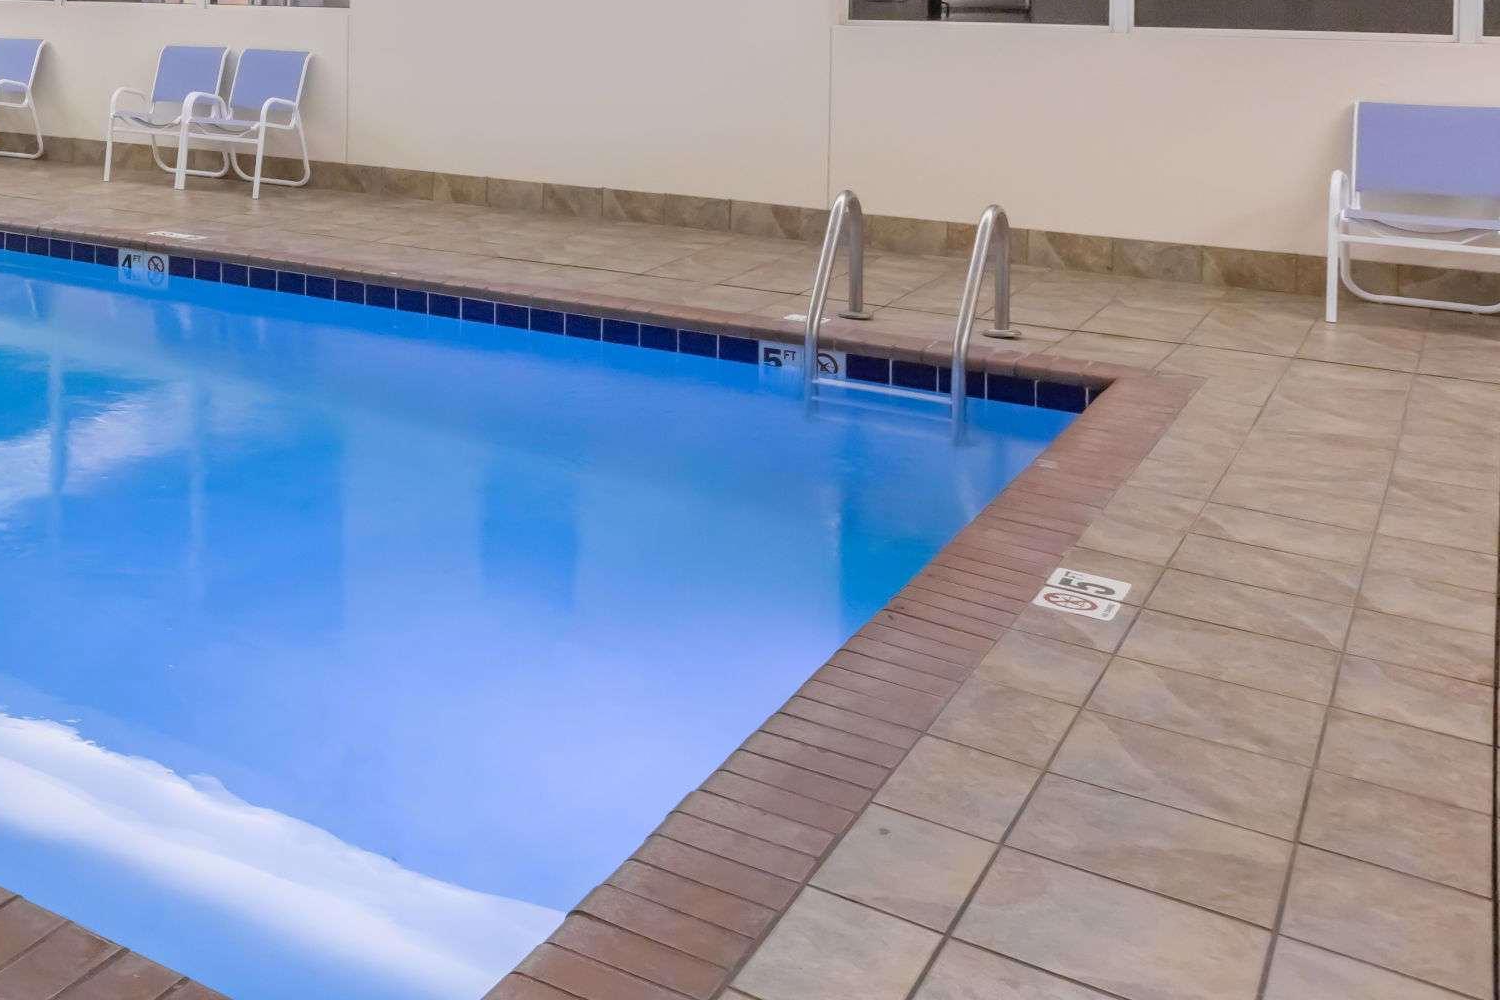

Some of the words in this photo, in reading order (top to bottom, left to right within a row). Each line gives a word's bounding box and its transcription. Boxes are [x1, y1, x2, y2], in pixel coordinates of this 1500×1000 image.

[764, 347, 782, 367] 5
[783, 350, 796, 360] FT
[1058, 577, 1116, 596] 5
